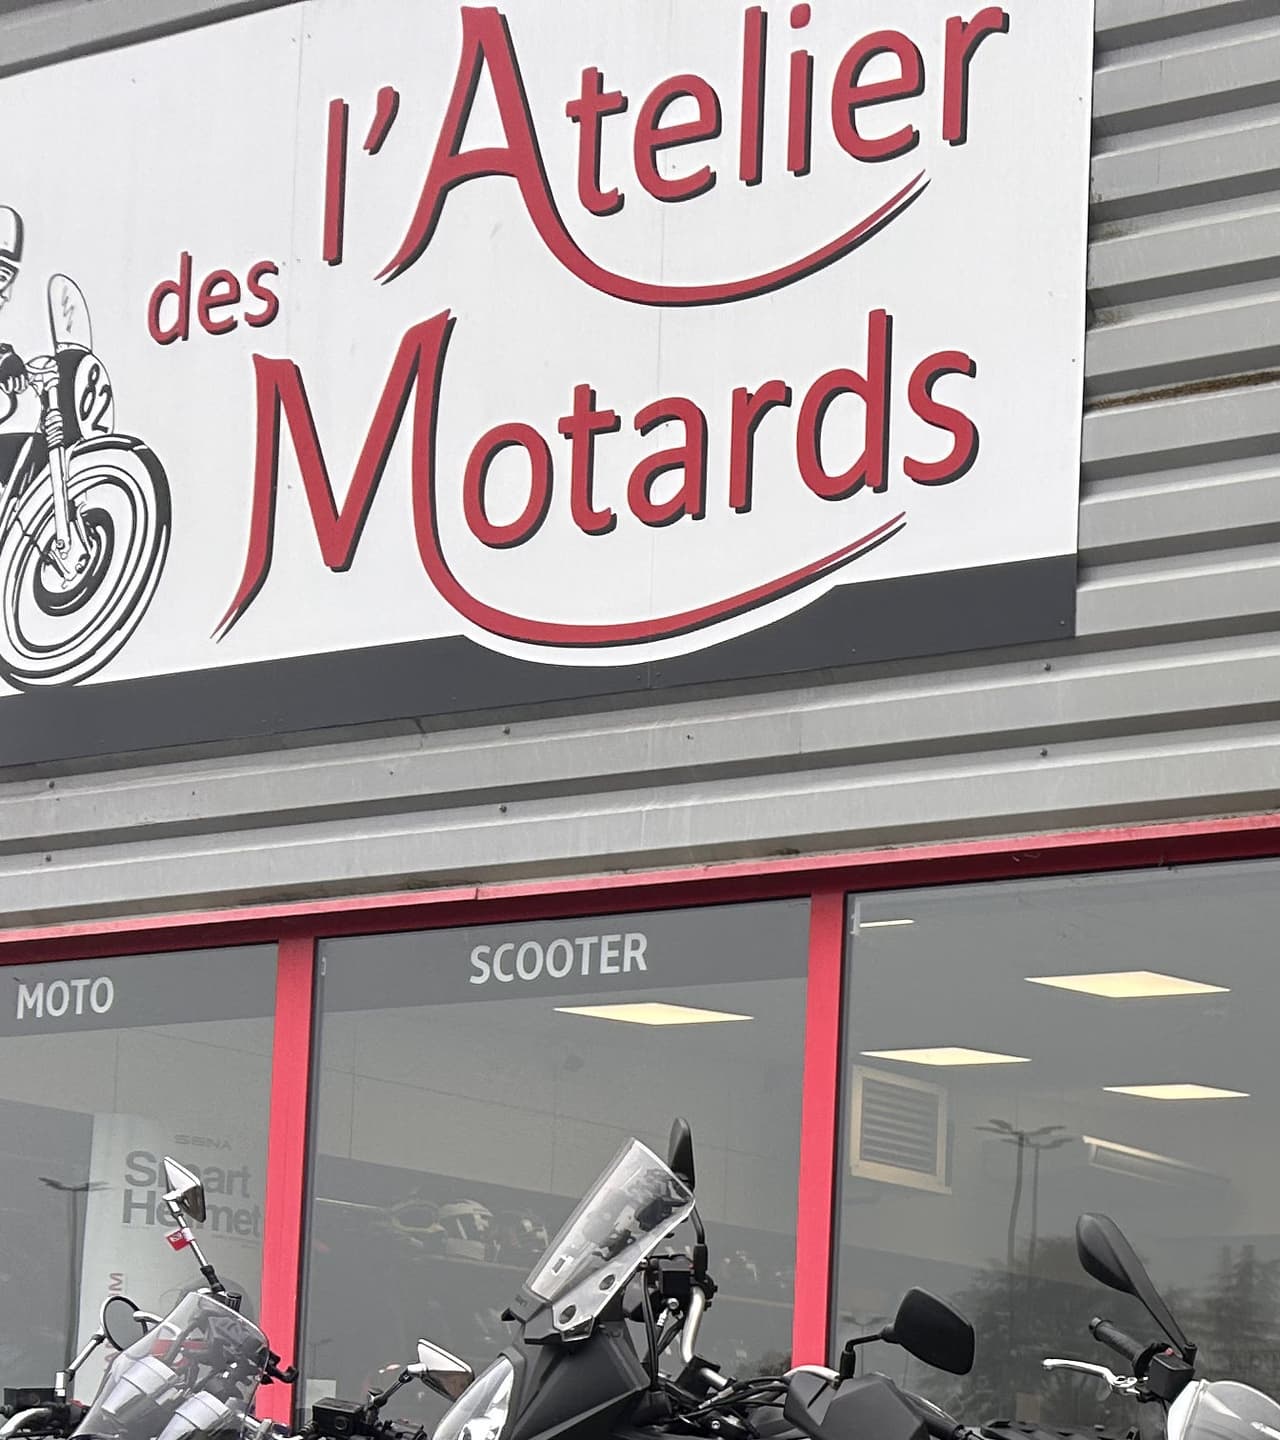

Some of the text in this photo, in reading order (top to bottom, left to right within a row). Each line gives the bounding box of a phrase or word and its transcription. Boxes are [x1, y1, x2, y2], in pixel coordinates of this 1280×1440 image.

[322, 4, 1009, 307] l'Atelier
[147, 252, 281, 345] des
[79, 363, 112, 434] 82
[212, 308, 979, 647] Motards
[469, 932, 648, 985] SCOOTER
[16, 976, 114, 1019] MOTO
[122, 1188, 262, 1237] Hemet
